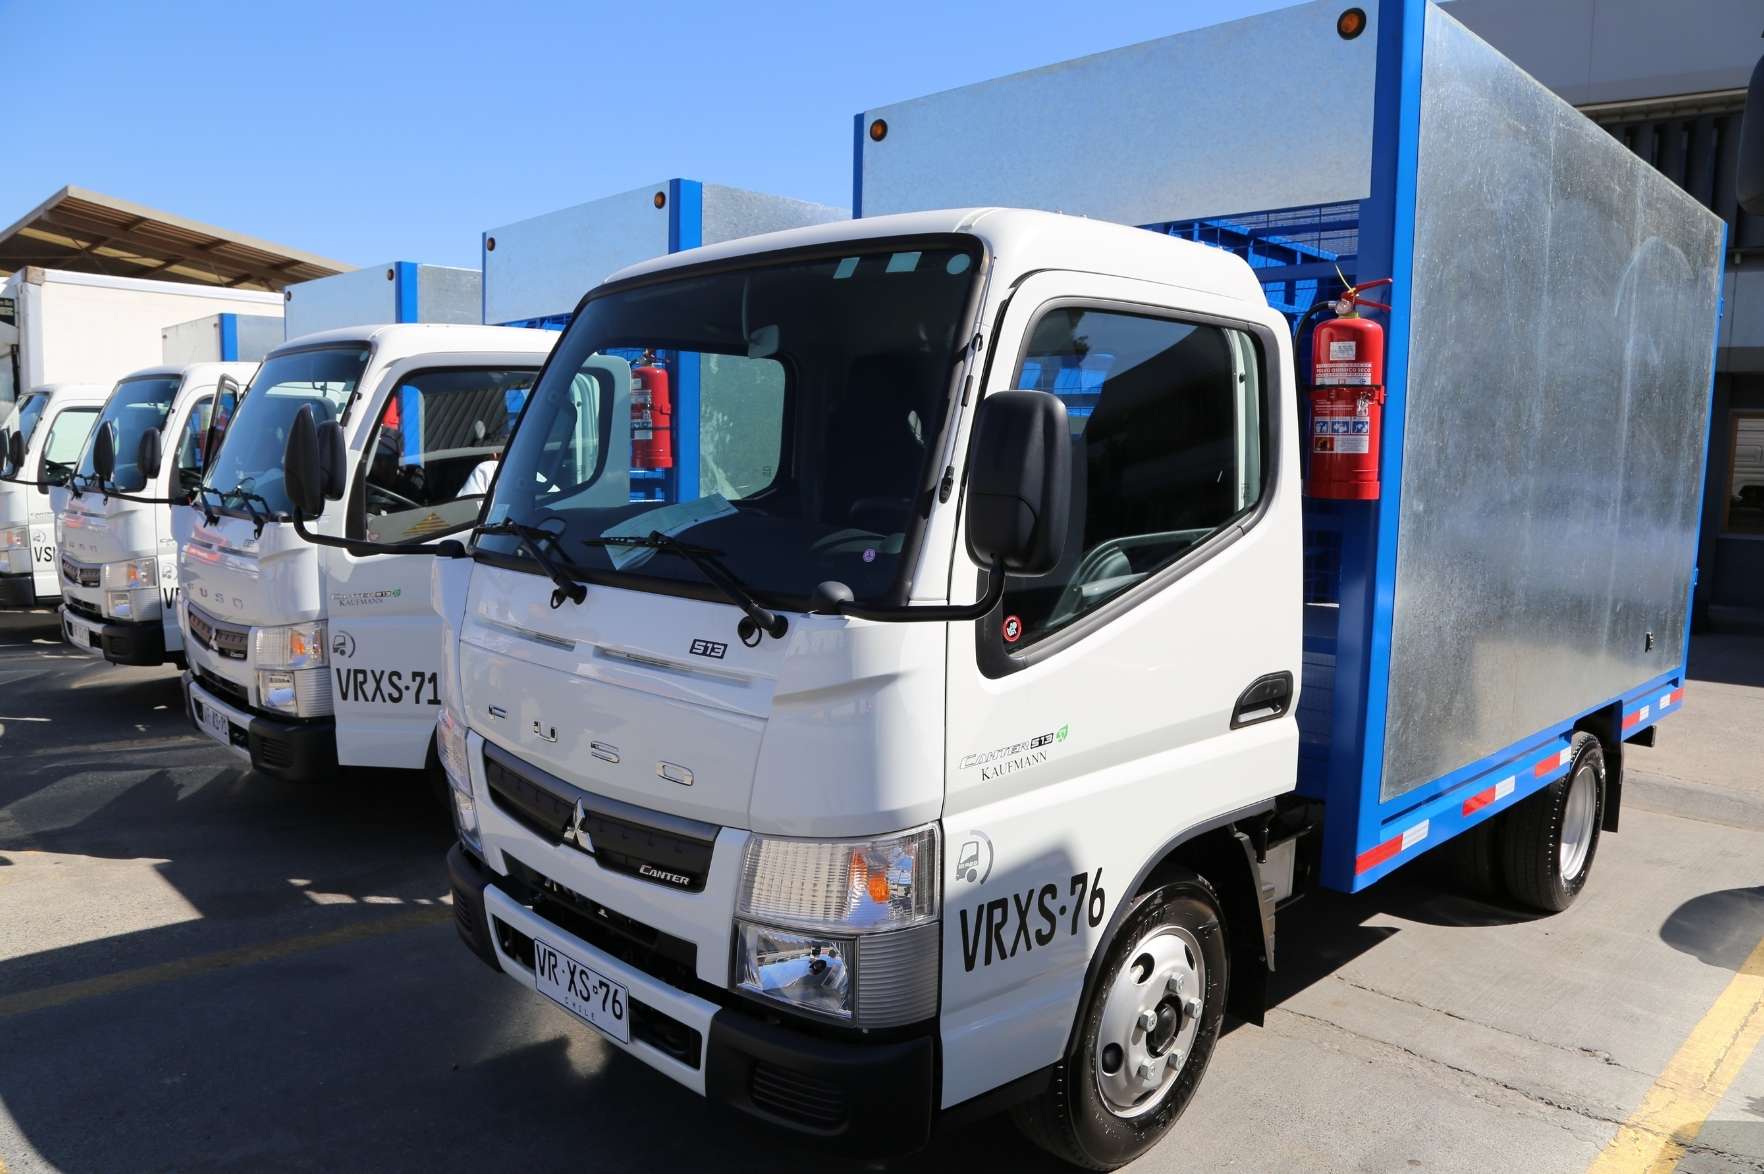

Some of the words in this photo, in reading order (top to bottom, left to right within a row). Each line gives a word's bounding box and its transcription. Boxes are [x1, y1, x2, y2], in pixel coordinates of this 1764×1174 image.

[690, 640, 727, 658] S13
[488, 704, 694, 787] FUSO
[960, 741, 1030, 769] CANTER
[981, 751, 1048, 781] KAUFMANN
[640, 864, 690, 885] CANTER
